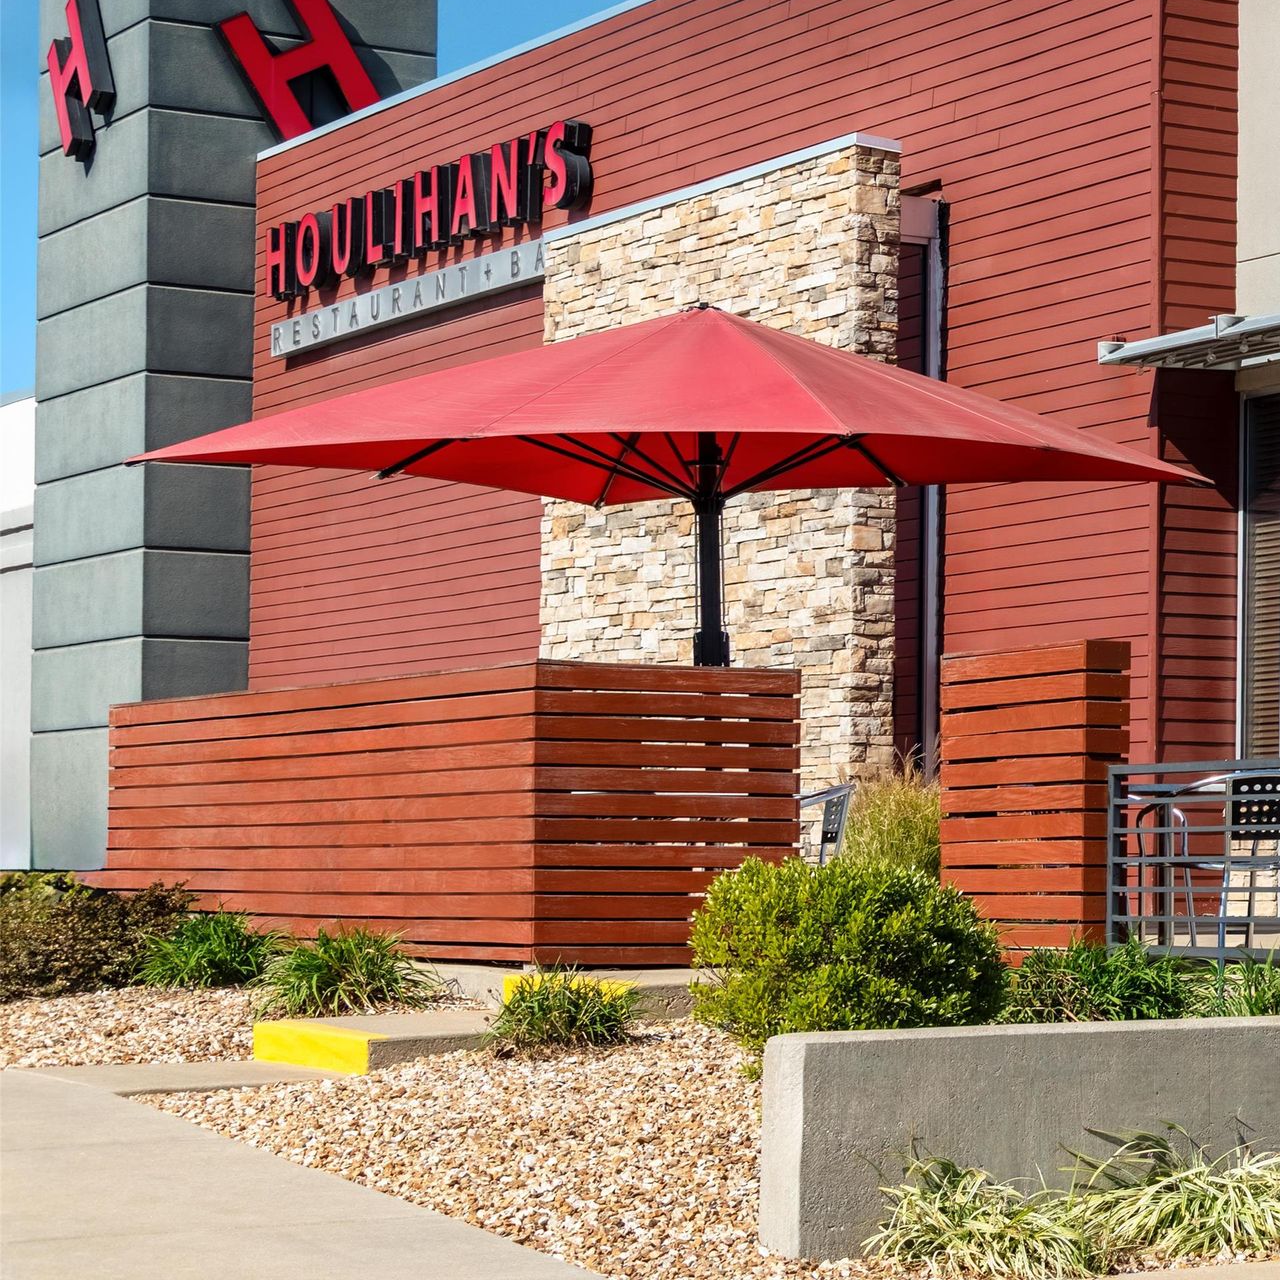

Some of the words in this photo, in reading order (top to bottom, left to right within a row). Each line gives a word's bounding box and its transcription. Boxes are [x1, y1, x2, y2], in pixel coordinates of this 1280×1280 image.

[265, 119, 593, 300] HOULIHAN'S
[272, 266, 468, 354] RESTAURANT
[510, 242, 545, 278] BA
